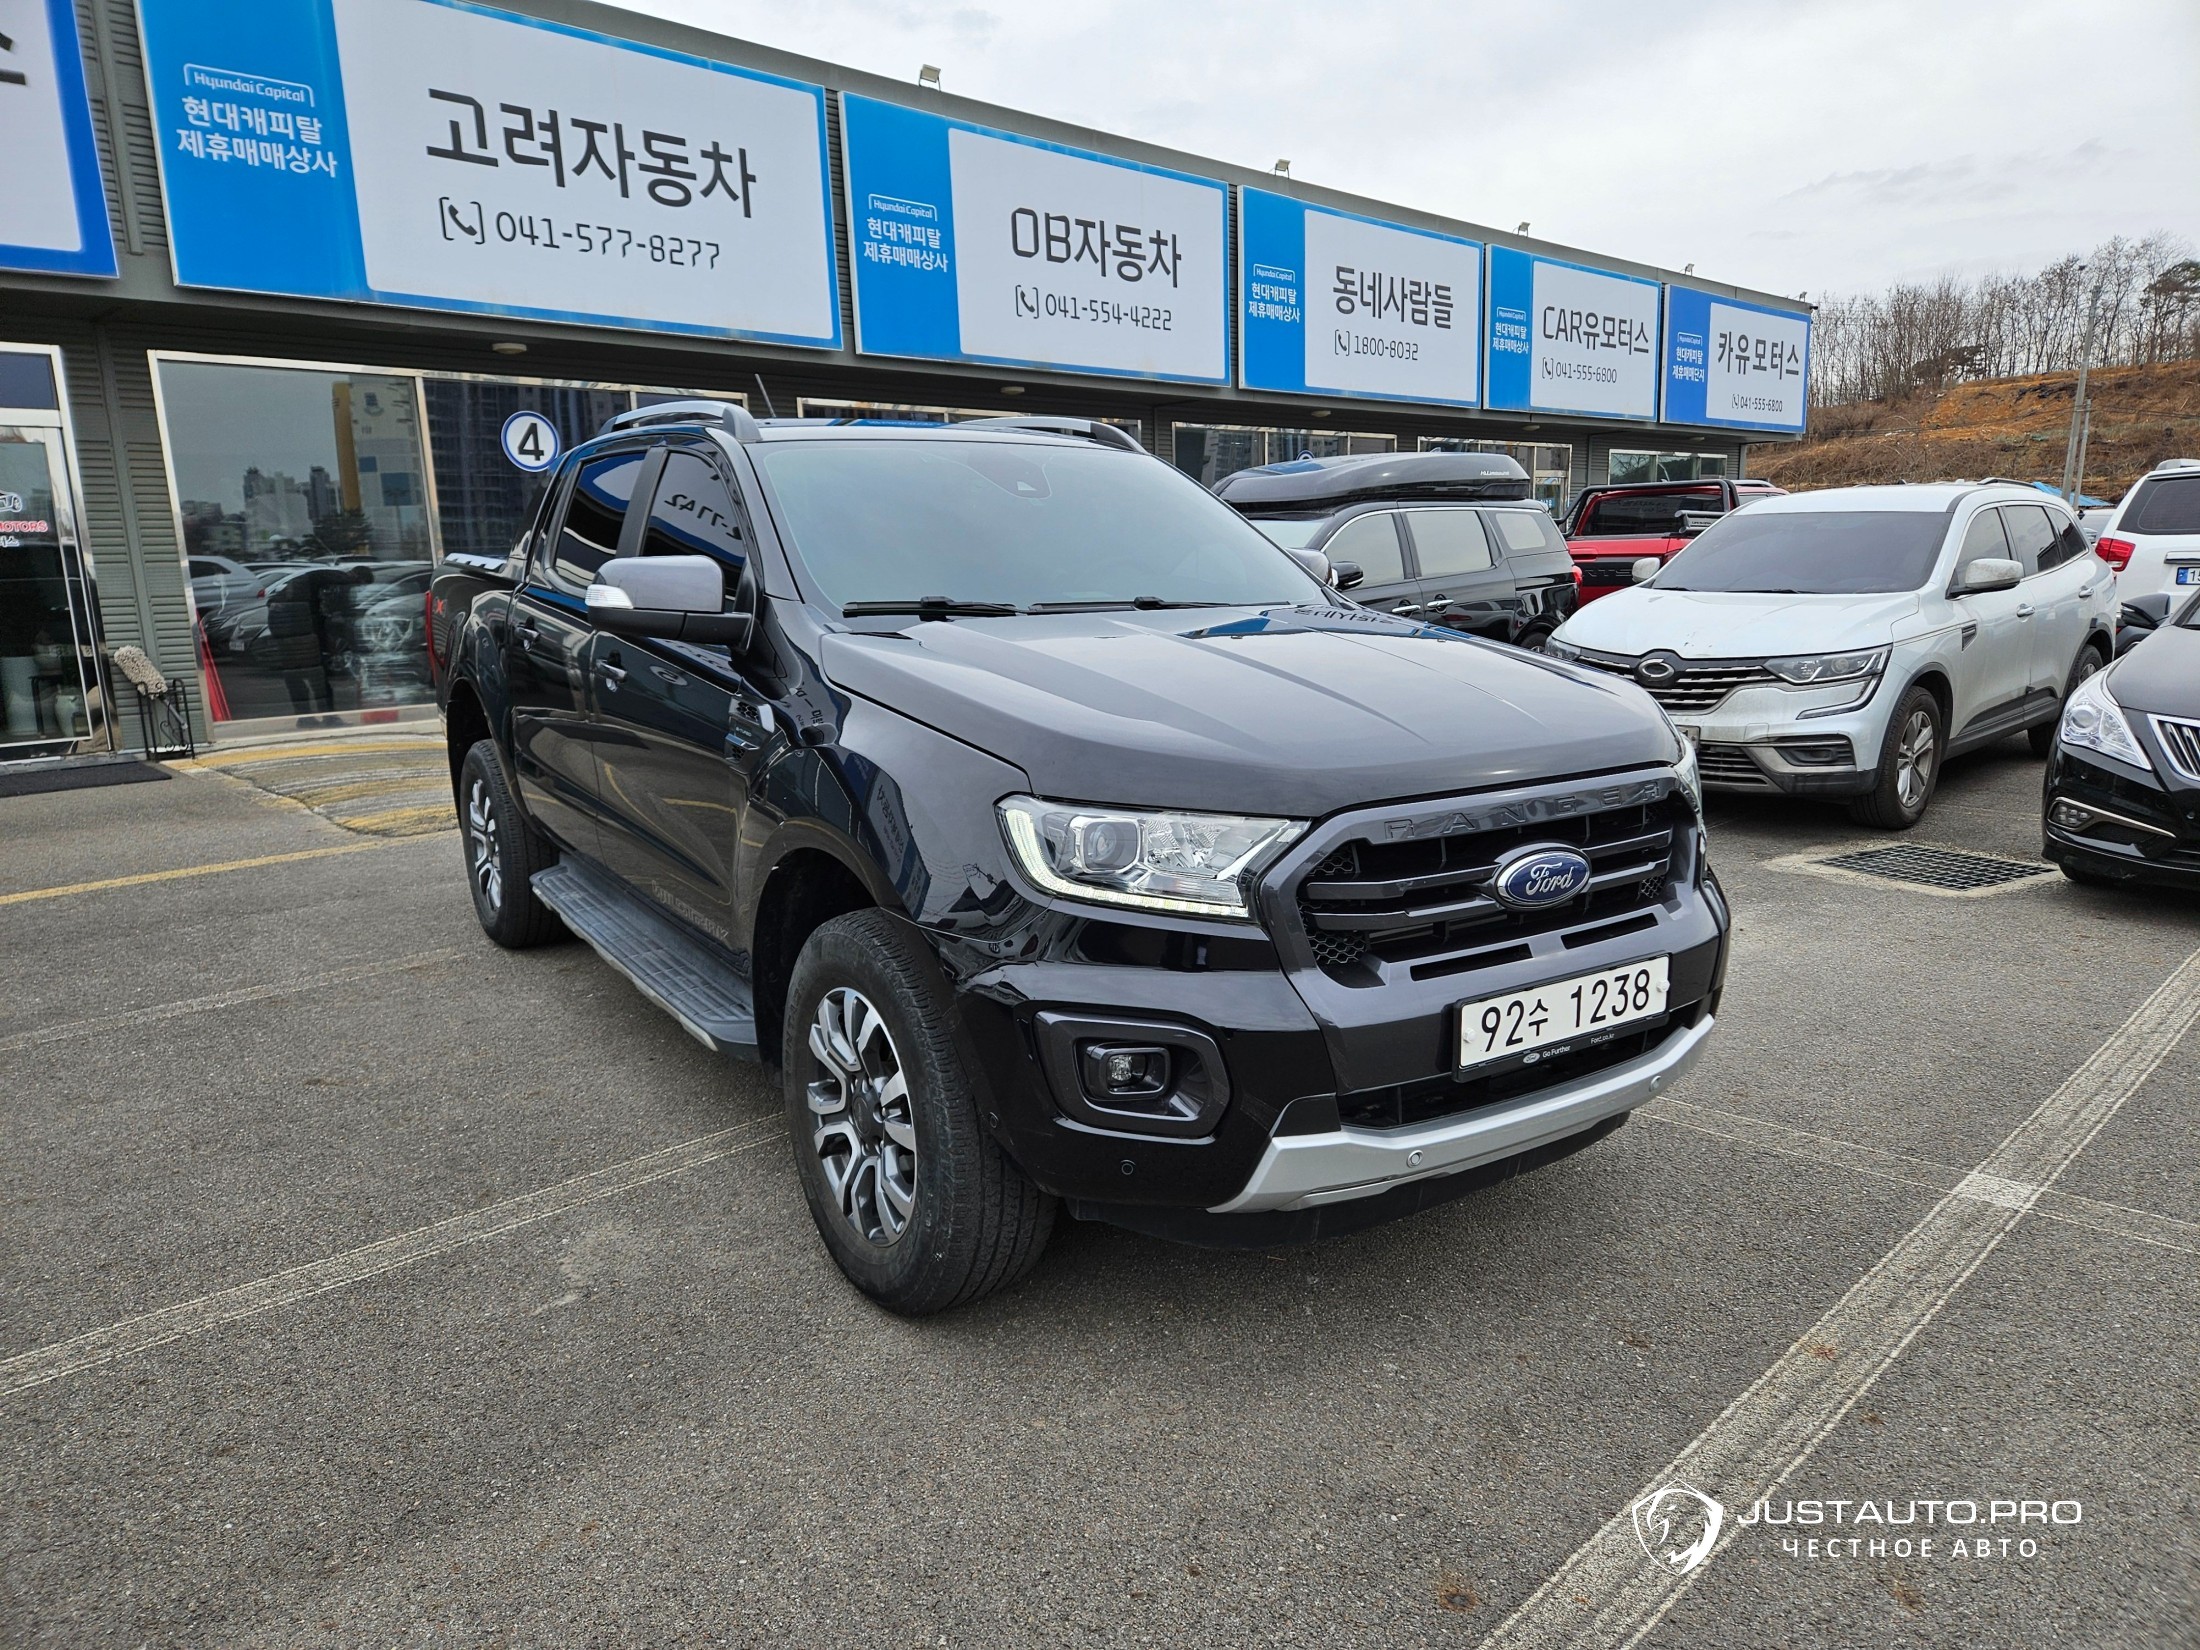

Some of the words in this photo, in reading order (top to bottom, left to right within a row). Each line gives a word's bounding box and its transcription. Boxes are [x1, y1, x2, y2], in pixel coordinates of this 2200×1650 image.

[194, 72, 254, 90] Hyundai
[256, 83, 304, 102] Capital
[182, 96, 322, 145] 현대캐피탈
[176, 129, 338, 178] 제휴매매상사
[426, 88, 757, 219] 고려자동차
[873, 199, 905, 212] Hyundai
[906, 206, 933, 218] Capital
[496, 219, 720, 270] 041-577-8277
[867, 217, 941, 249] 현대캐피탈
[1010, 207, 1181, 288] OB자동차
[863, 241, 948, 272] 제휴매매상사
[1045, 293, 1172, 331] 041-554-4222
[1248, 301, 1301, 323] 제휴매매상사
[1252, 282, 1297, 305] 현대캐피탈
[1332, 264, 1454, 329] 동네사람들
[1354, 337, 1419, 361] 1800-8032
[1543, 306, 1650, 355] CAR유모터스
[1556, 362, 1617, 384] 041-555-6800
[1717, 331, 1799, 380] 카유모터스
[1740, 396, 1783, 412] 041-555-6800
[518, 422, 545, 462] 4
[1384, 781, 1660, 840] RANGER
[1525, 861, 1574, 896] Ford
[1481, 998, 1549, 1052] 92수
[1570, 968, 1651, 1028] 1238
[1551, 1045, 1571, 1056] Further
